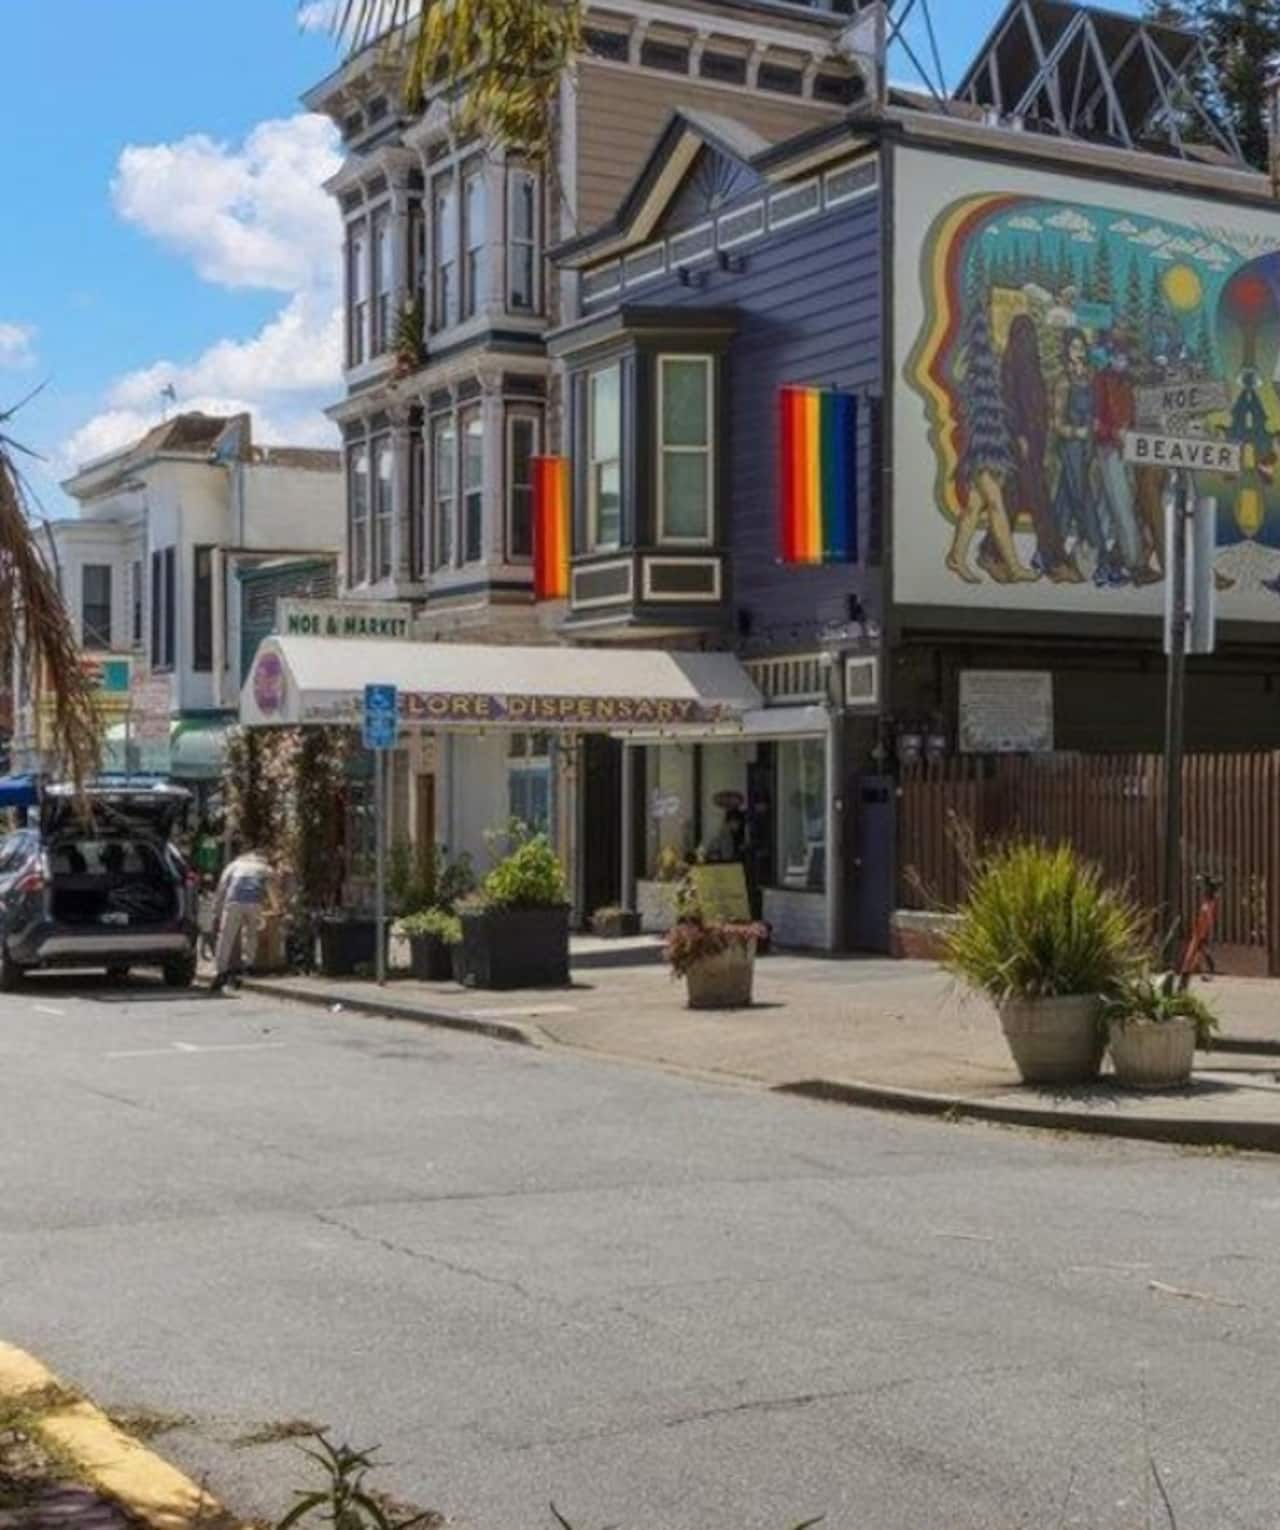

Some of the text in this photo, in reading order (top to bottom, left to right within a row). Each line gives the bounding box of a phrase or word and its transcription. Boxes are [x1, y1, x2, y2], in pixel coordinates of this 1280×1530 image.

[1162, 387, 1200, 409] NOE
[1135, 438, 1231, 465] BEAVER
[288, 614, 406, 637] NOE & MARKET
[508, 699, 692, 719] DISPENSARY
